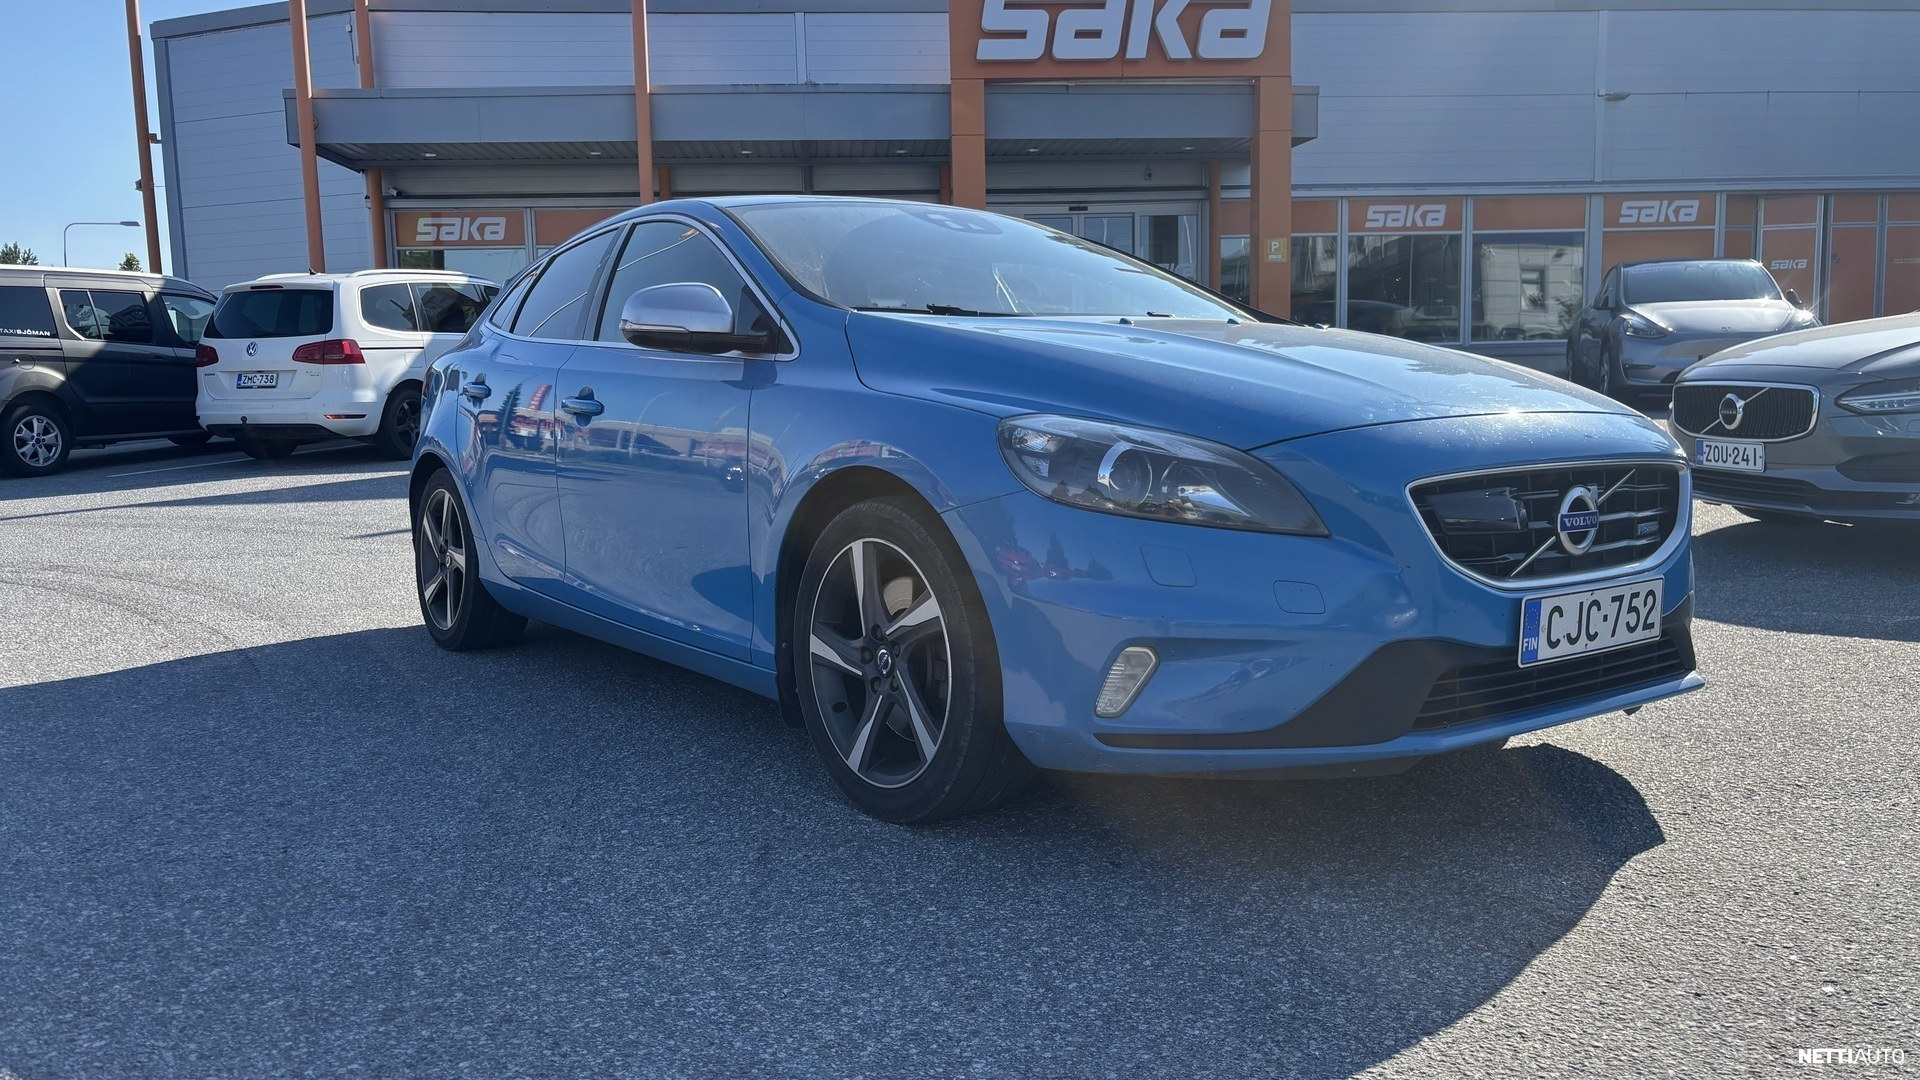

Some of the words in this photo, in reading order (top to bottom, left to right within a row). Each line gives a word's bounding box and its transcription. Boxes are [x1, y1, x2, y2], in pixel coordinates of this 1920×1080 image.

[242, 374, 275, 385] ZMC-738
[1705, 444, 1757, 467] ZOU-241
[1563, 515, 1597, 527] VOLVO
[1546, 588, 1657, 650] CJC-752
[1523, 636, 1538, 652] FIN
